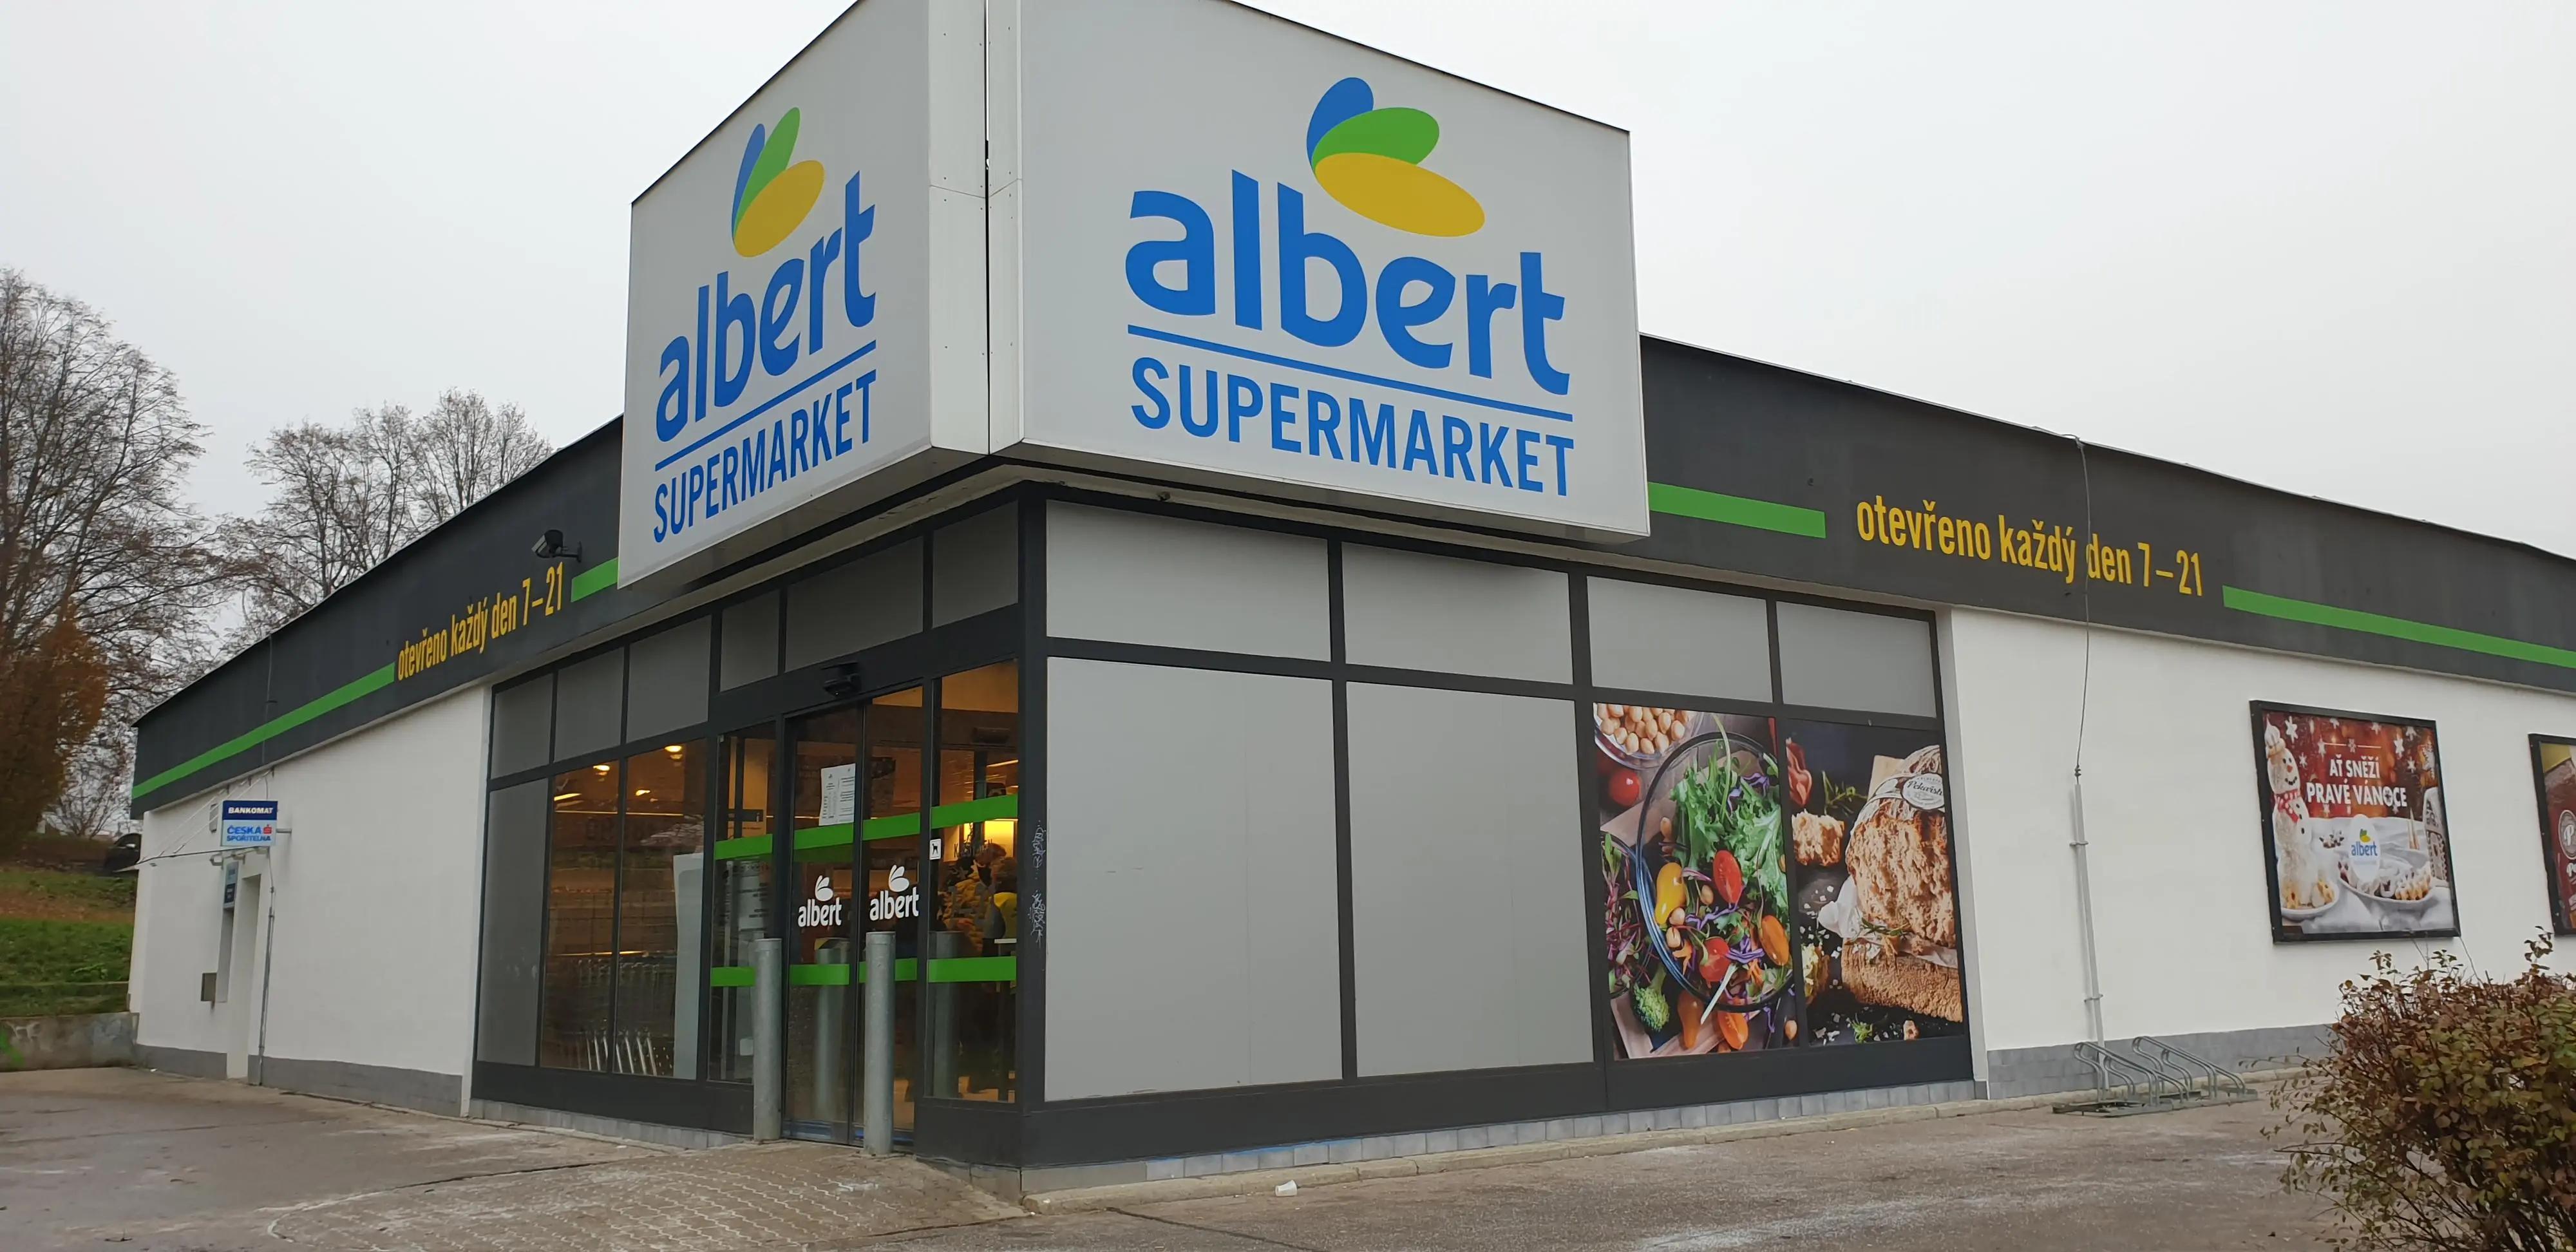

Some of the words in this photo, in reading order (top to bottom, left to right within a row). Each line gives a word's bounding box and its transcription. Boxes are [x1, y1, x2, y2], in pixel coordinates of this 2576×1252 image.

[656, 170, 876, 442] albert
[1124, 169, 1570, 396] albert
[654, 369, 876, 543] SUPERMARKET
[1131, 357, 1575, 497] SUPERMARKET
[1857, 495, 1992, 561] otevřeno
[1998, 514, 2076, 584] každý
[2086, 533, 2132, 585] den
[398, 627, 448, 681] otevřeno
[451, 596, 488, 654] každý
[491, 592, 518, 639] den
[2306, 778, 2351, 804] PRAVÉ
[2353, 779, 2407, 808] VÁNOCE
[2345, 755, 2380, 779] SNĚŽÍ
[2351, 840, 2378, 857] albert
[797, 896, 842, 927] albert
[869, 886, 920, 922] albert
